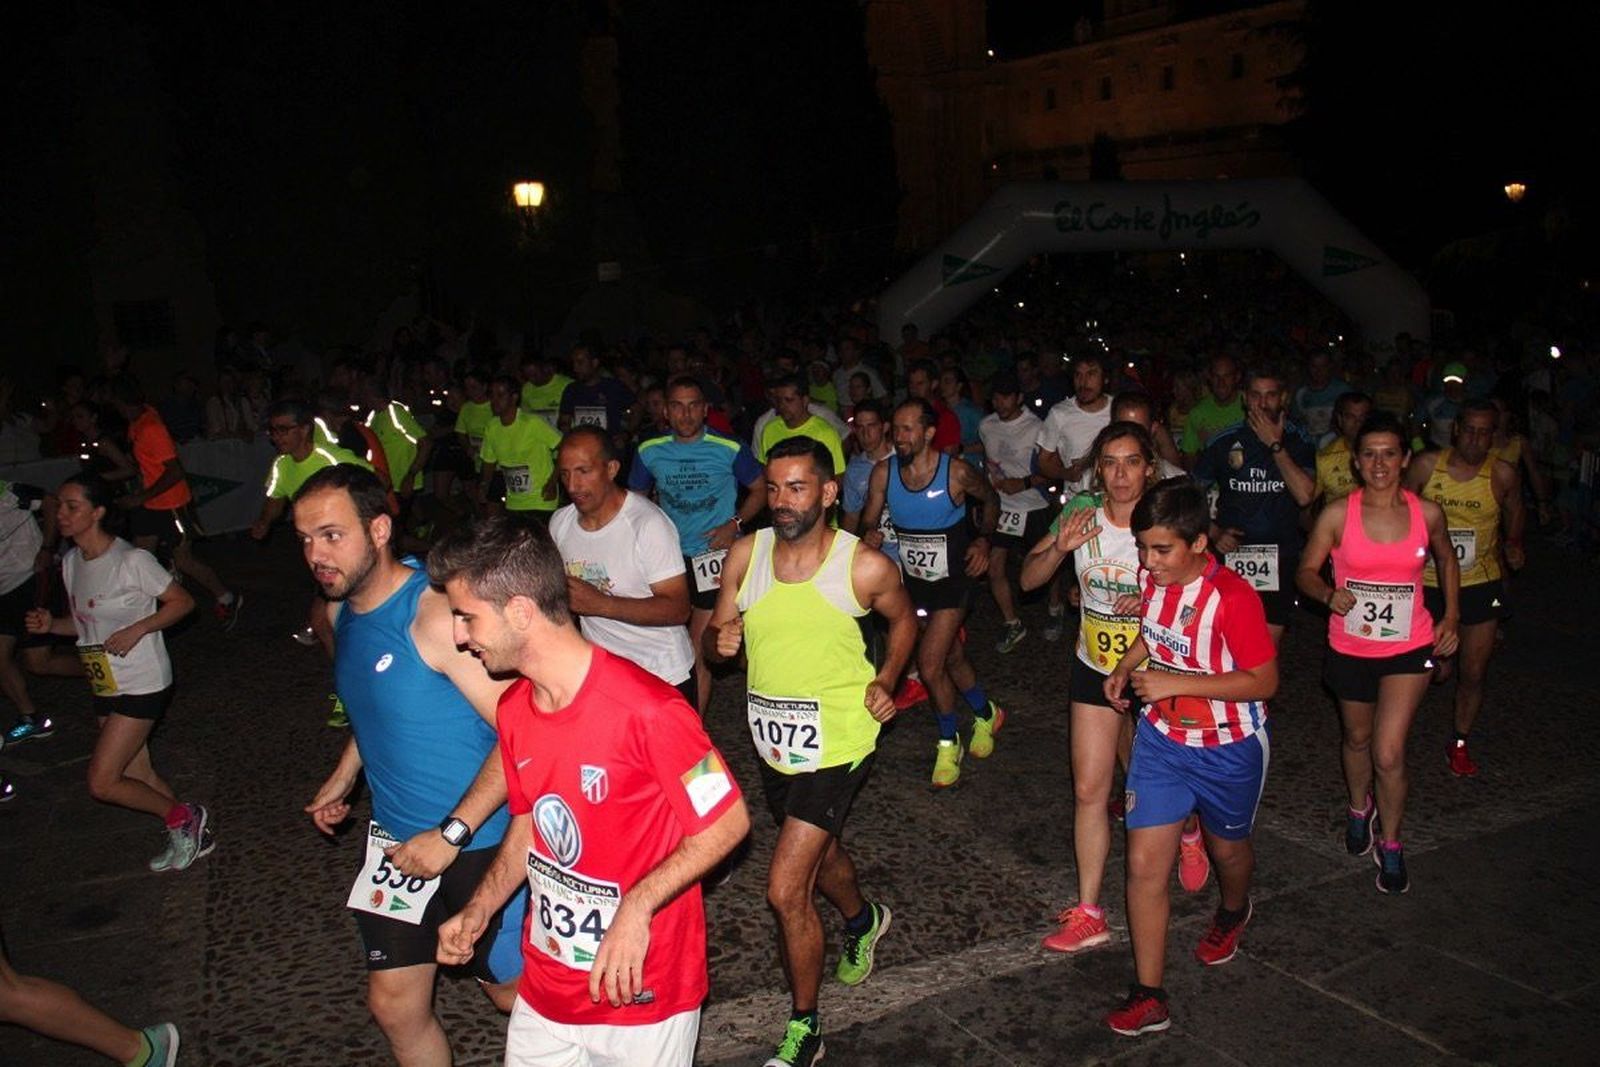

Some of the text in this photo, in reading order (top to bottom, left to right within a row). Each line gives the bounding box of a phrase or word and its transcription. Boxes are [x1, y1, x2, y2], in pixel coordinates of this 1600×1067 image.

[1054, 192, 1260, 241] El Corte Inglés
[1229, 477, 1286, 494] Emirates
[1249, 467, 1267, 480] Fly
[907, 549, 938, 567] 527
[1235, 560, 1270, 577] 894
[1363, 601, 1394, 624] 34
[1097, 630, 1128, 655] 93
[1142, 625, 1188, 655] Plus500
[753, 716, 819, 750] 1072
[539, 892, 607, 942] 634
